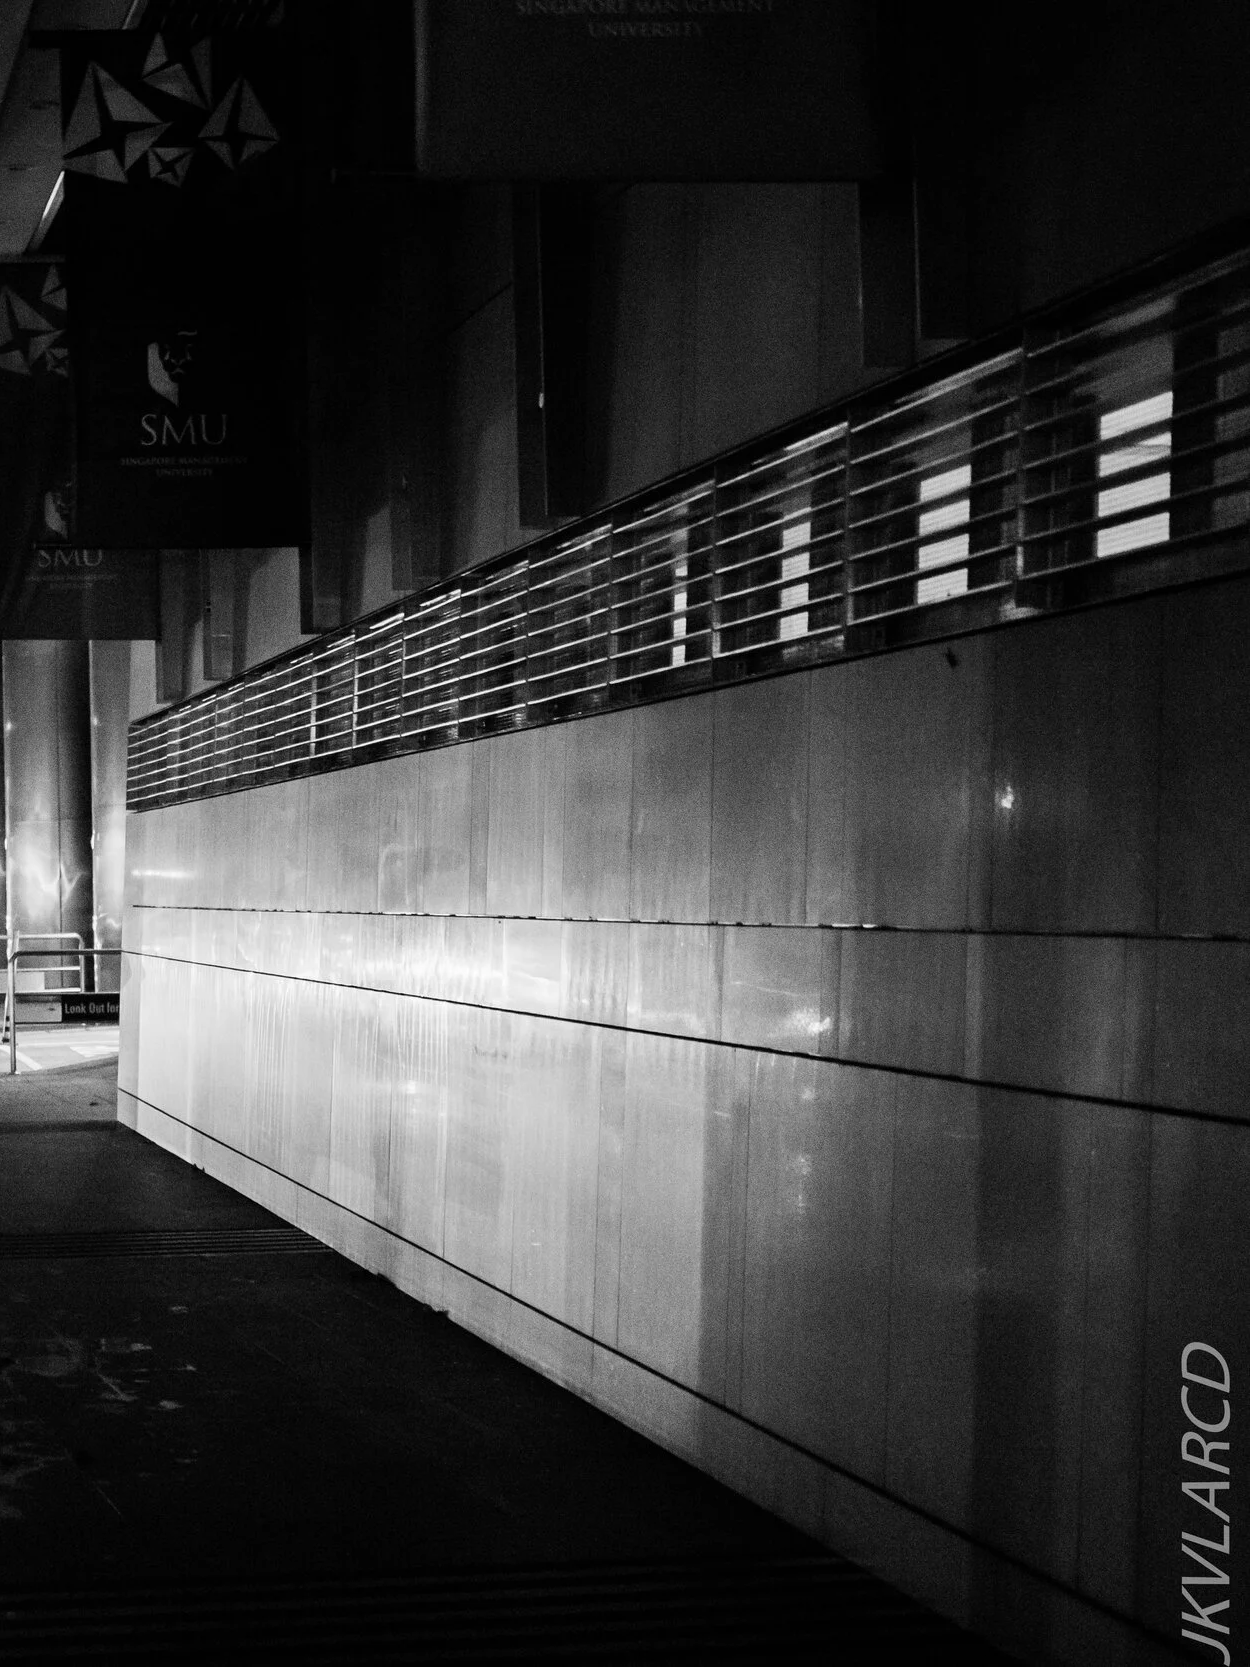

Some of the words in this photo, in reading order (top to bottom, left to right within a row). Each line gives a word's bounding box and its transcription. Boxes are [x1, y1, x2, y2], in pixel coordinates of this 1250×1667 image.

[140, 413, 228, 446] SMU
[64, 1002, 87, 1015] Look
[88, 1001, 105, 1014] Out
